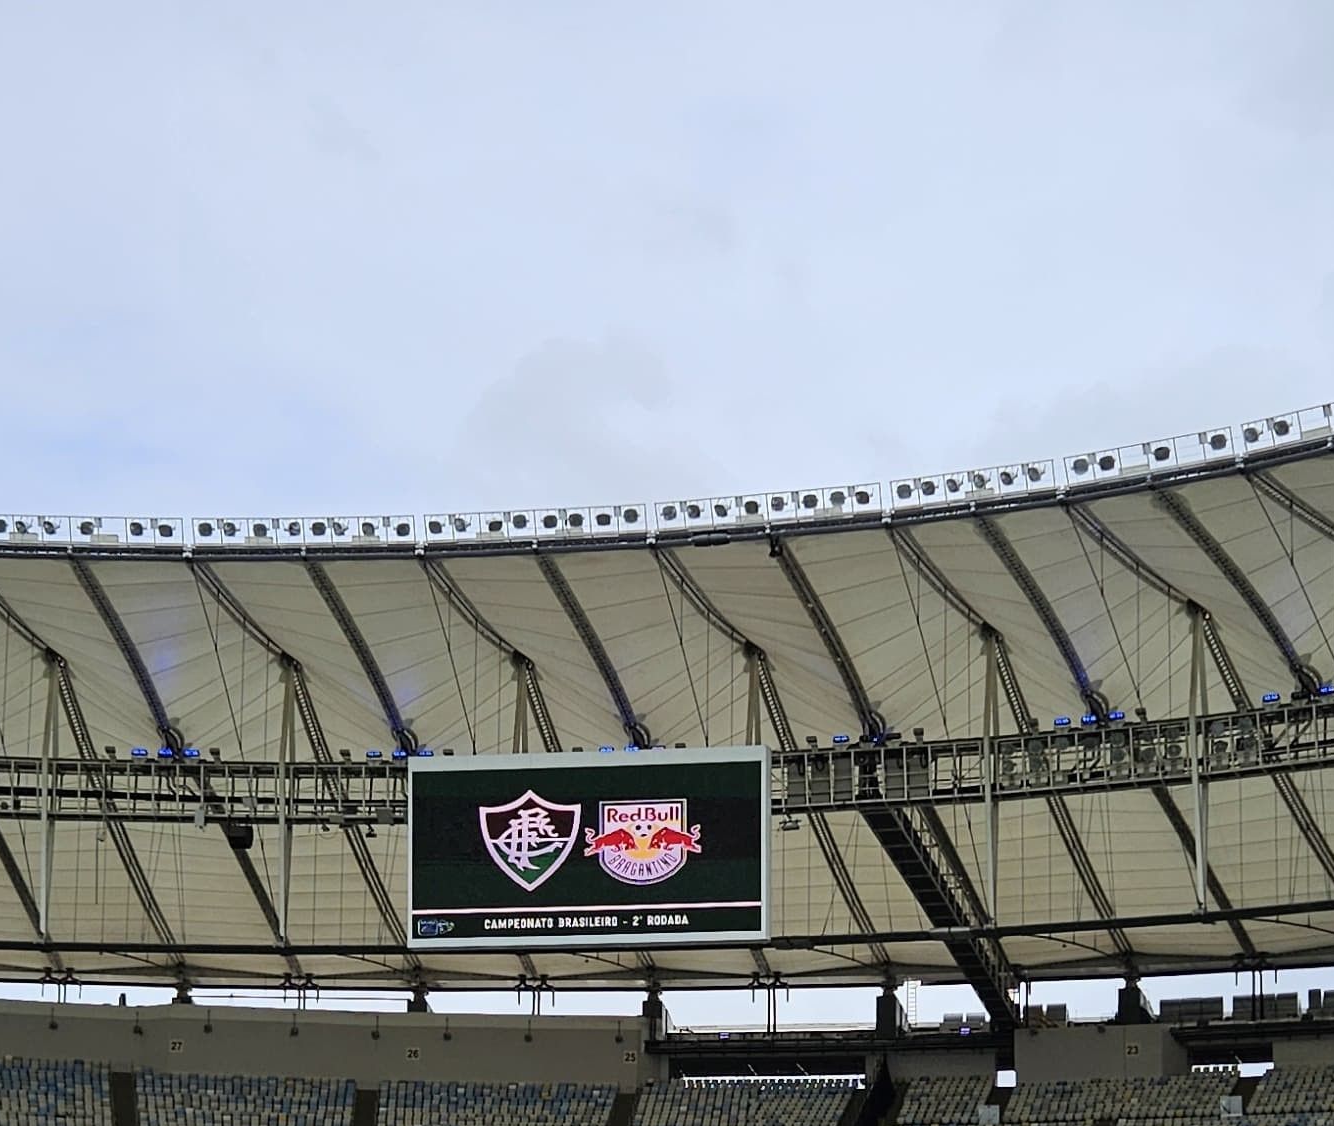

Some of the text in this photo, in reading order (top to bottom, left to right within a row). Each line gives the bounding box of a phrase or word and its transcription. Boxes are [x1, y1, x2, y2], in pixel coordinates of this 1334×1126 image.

[607, 806, 680, 823] Red Bull
[608, 852, 678, 877] BRAGANTINO
[483, 917, 554, 930] CAMPEONATO
[557, 916, 618, 929] BRASILEIRO
[646, 914, 689, 927] RODADA
[170, 1041, 184, 1052] 27
[1126, 1045, 1139, 1056] 23
[407, 1049, 420, 1060] 26
[624, 1052, 637, 1063] 25
